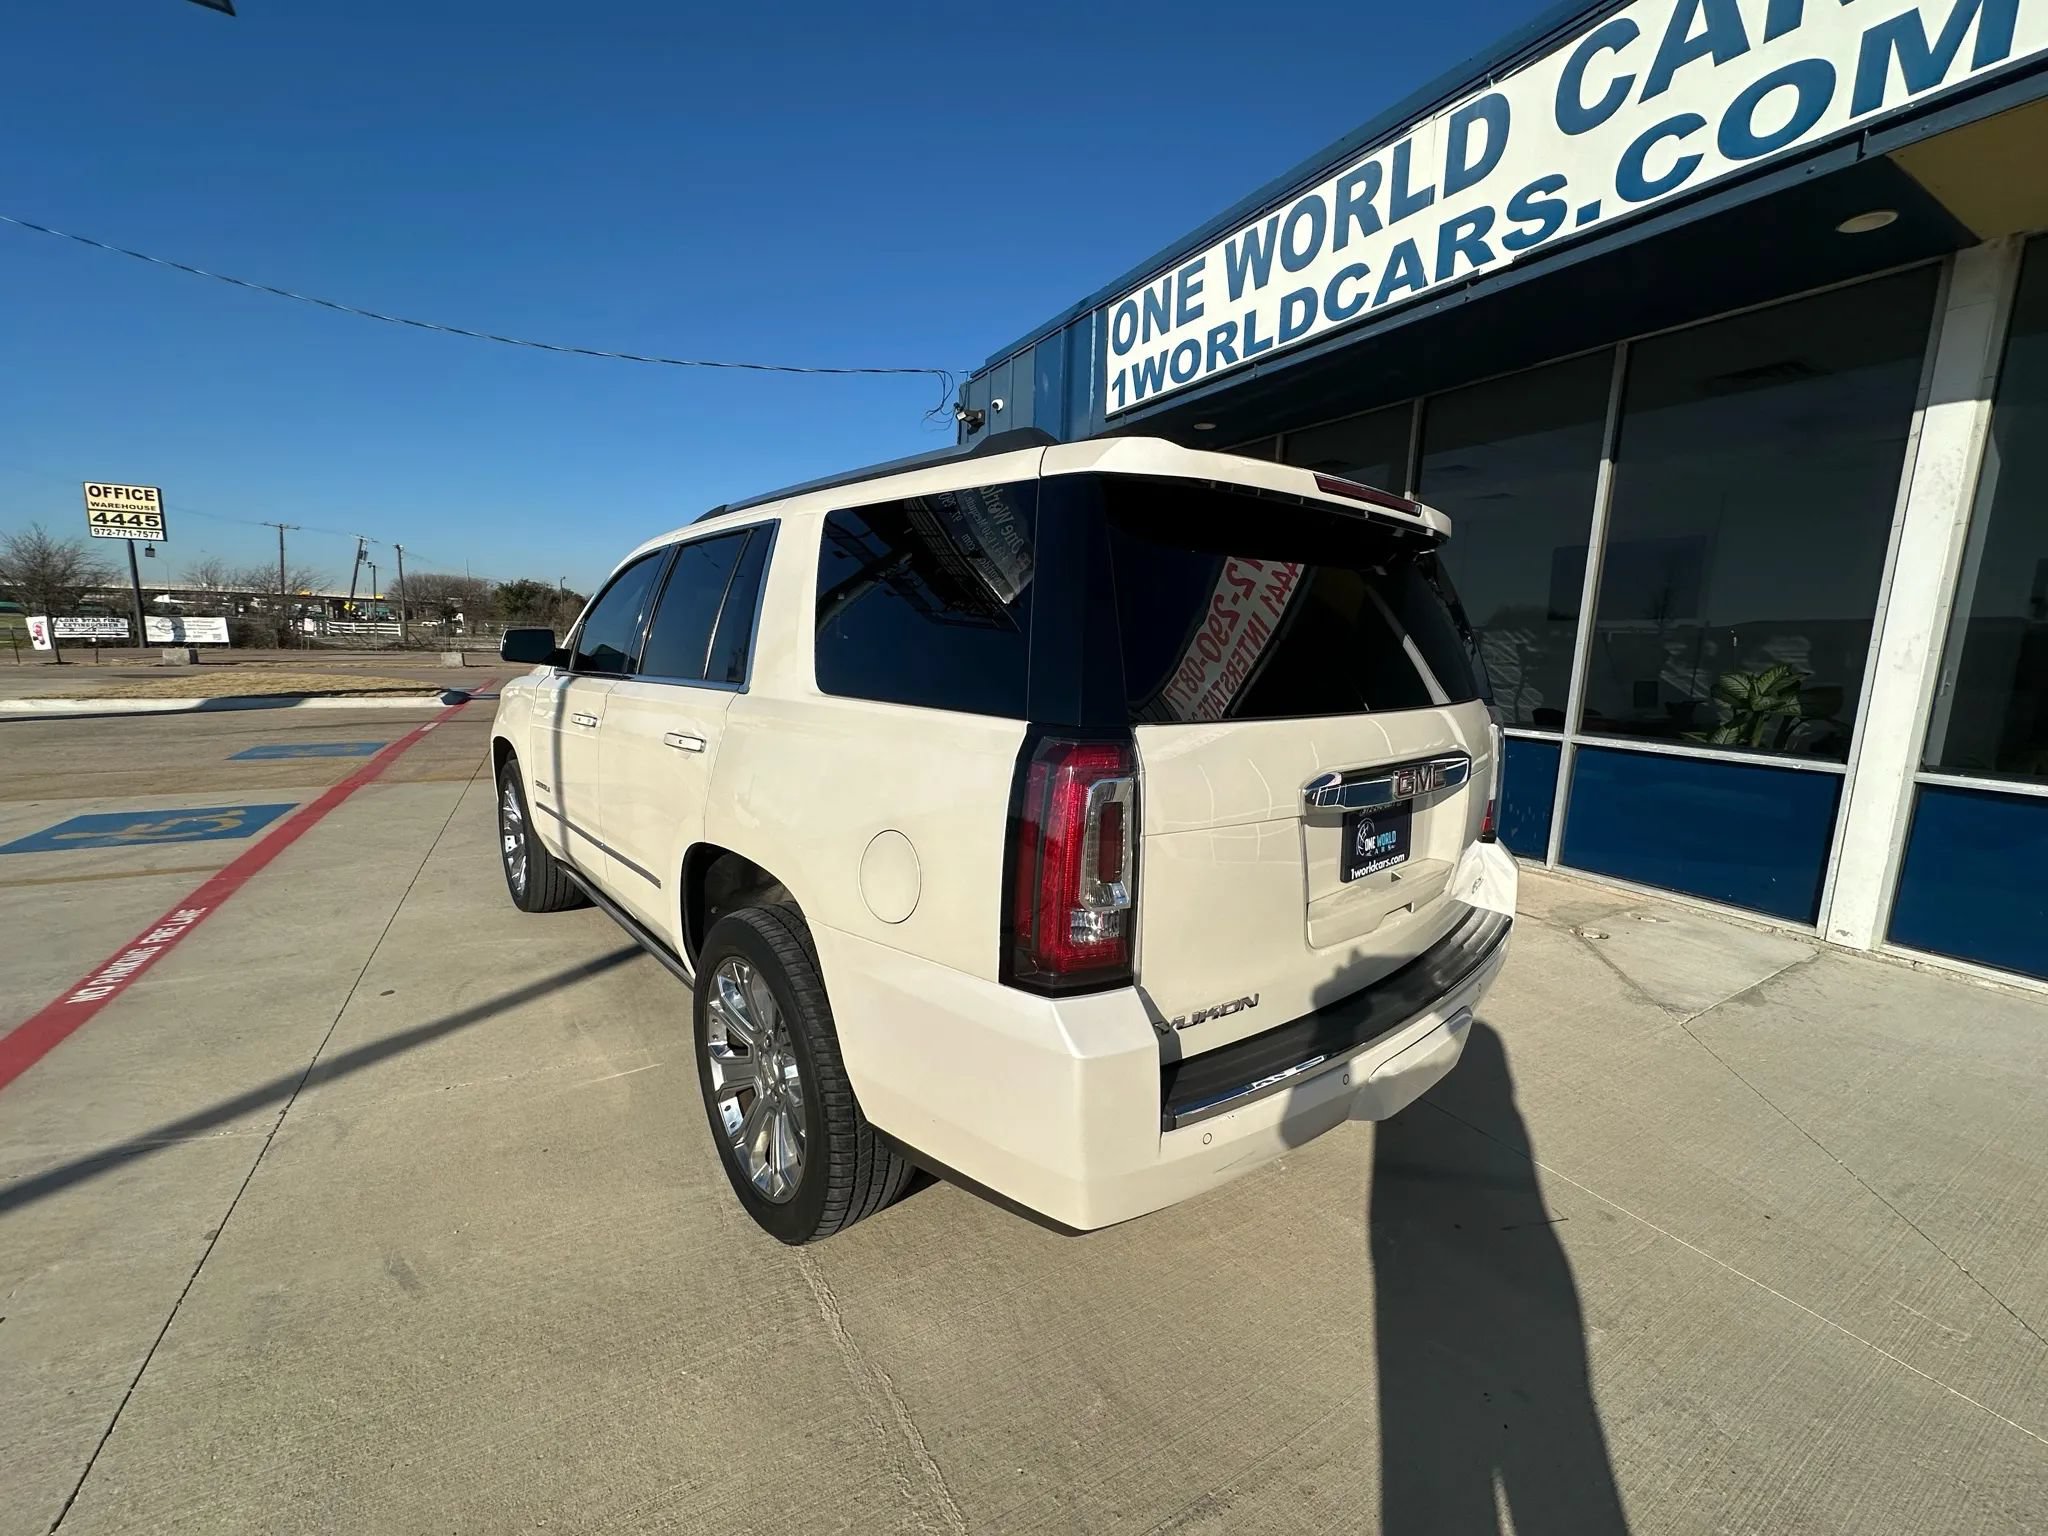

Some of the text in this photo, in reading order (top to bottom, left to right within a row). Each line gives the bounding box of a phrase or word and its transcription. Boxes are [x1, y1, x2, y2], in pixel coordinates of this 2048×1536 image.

[1111, 0, 2020, 407] 1WORLDCARS.COM
[1112, 256, 1206, 357] ONE
[1225, 92, 1511, 303] WORLD
[88, 485, 155, 502] OFFICE
[90, 501, 157, 511] WAREHOUSE
[93, 512, 159, 527] 4445
[94, 527, 160, 538] 972-771-7577
[1393, 763, 1447, 799] GMC
[1364, 830, 1397, 852] ONE WORLD
[1351, 853, 1405, 879] 1worldcars.com
[64, 985, 115, 1004] NO
[1154, 993, 1260, 1035] YUKON
